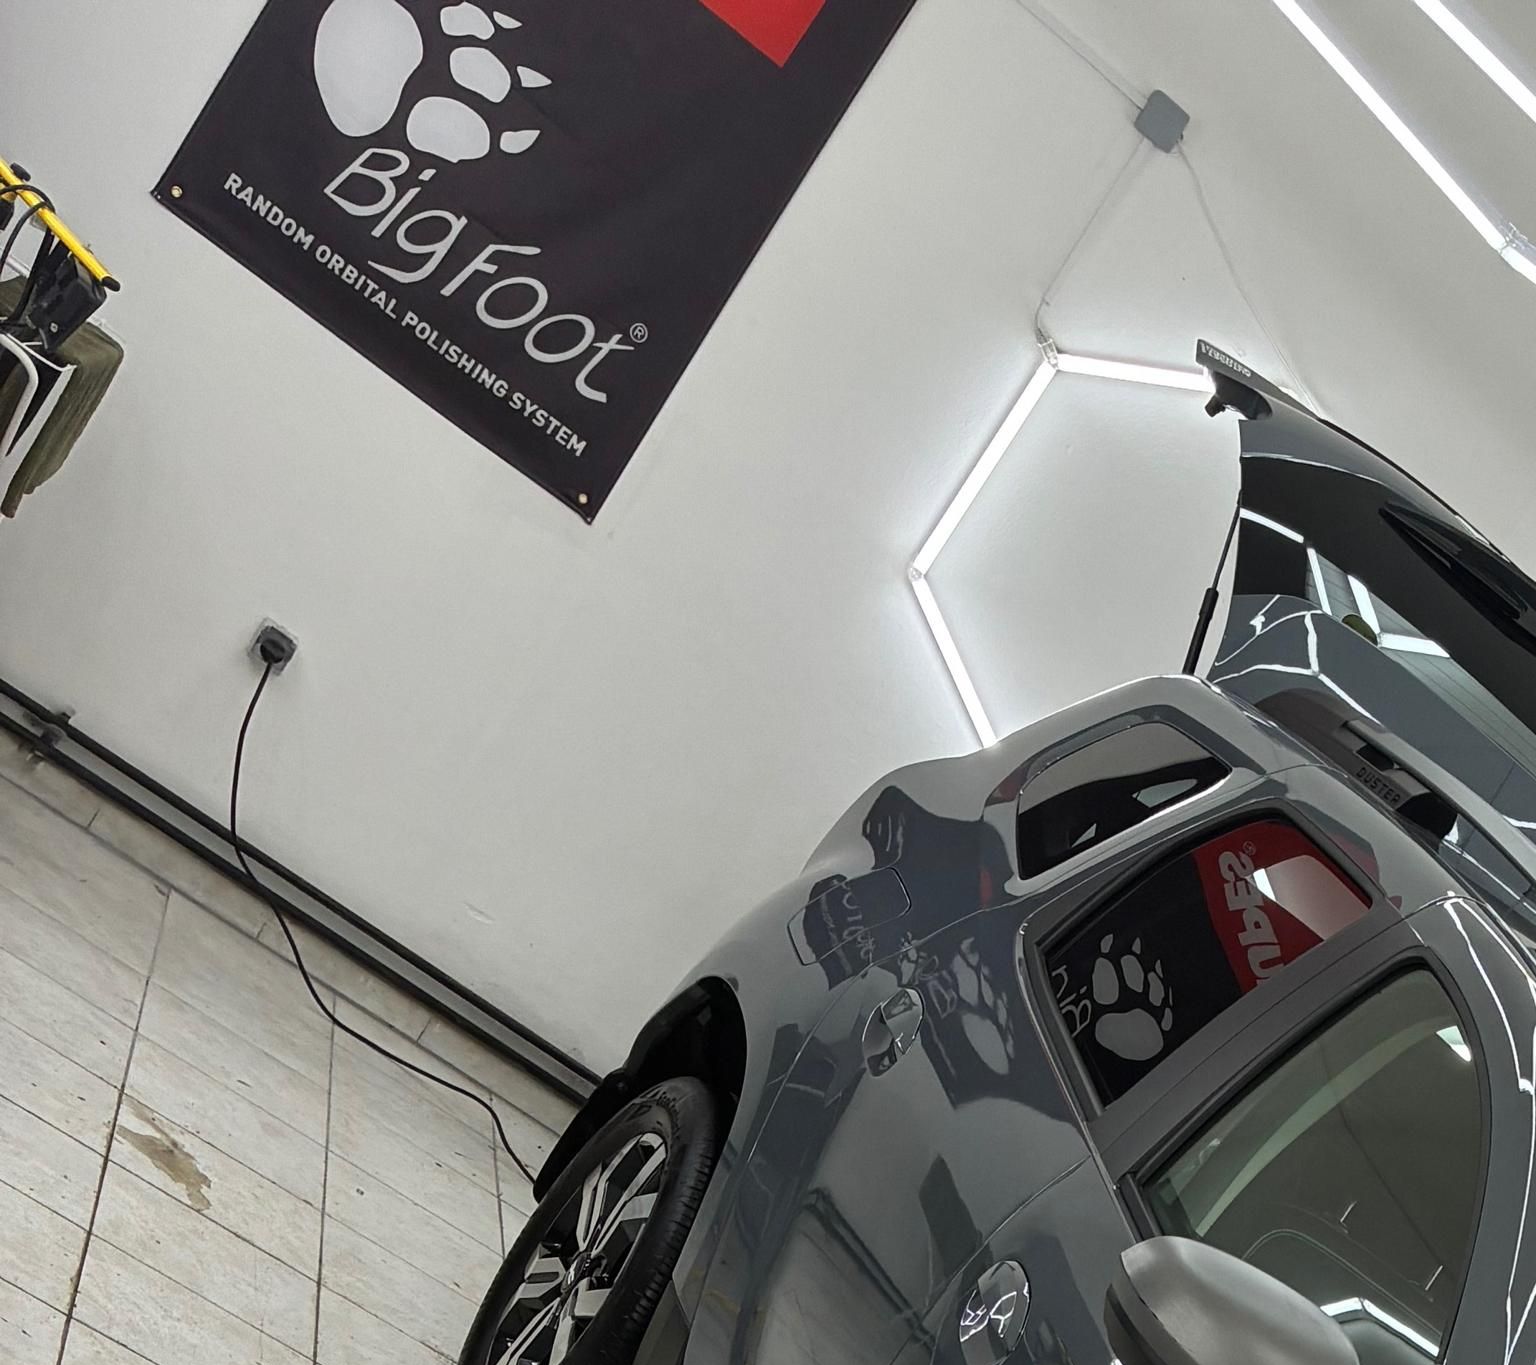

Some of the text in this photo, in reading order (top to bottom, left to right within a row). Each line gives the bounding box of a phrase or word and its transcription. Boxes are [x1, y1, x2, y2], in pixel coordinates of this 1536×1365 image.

[224, 172, 588, 457] RANDOM ORBITAL POLISHING SYSTEM
[1356, 767, 1401, 803] DUSTER
